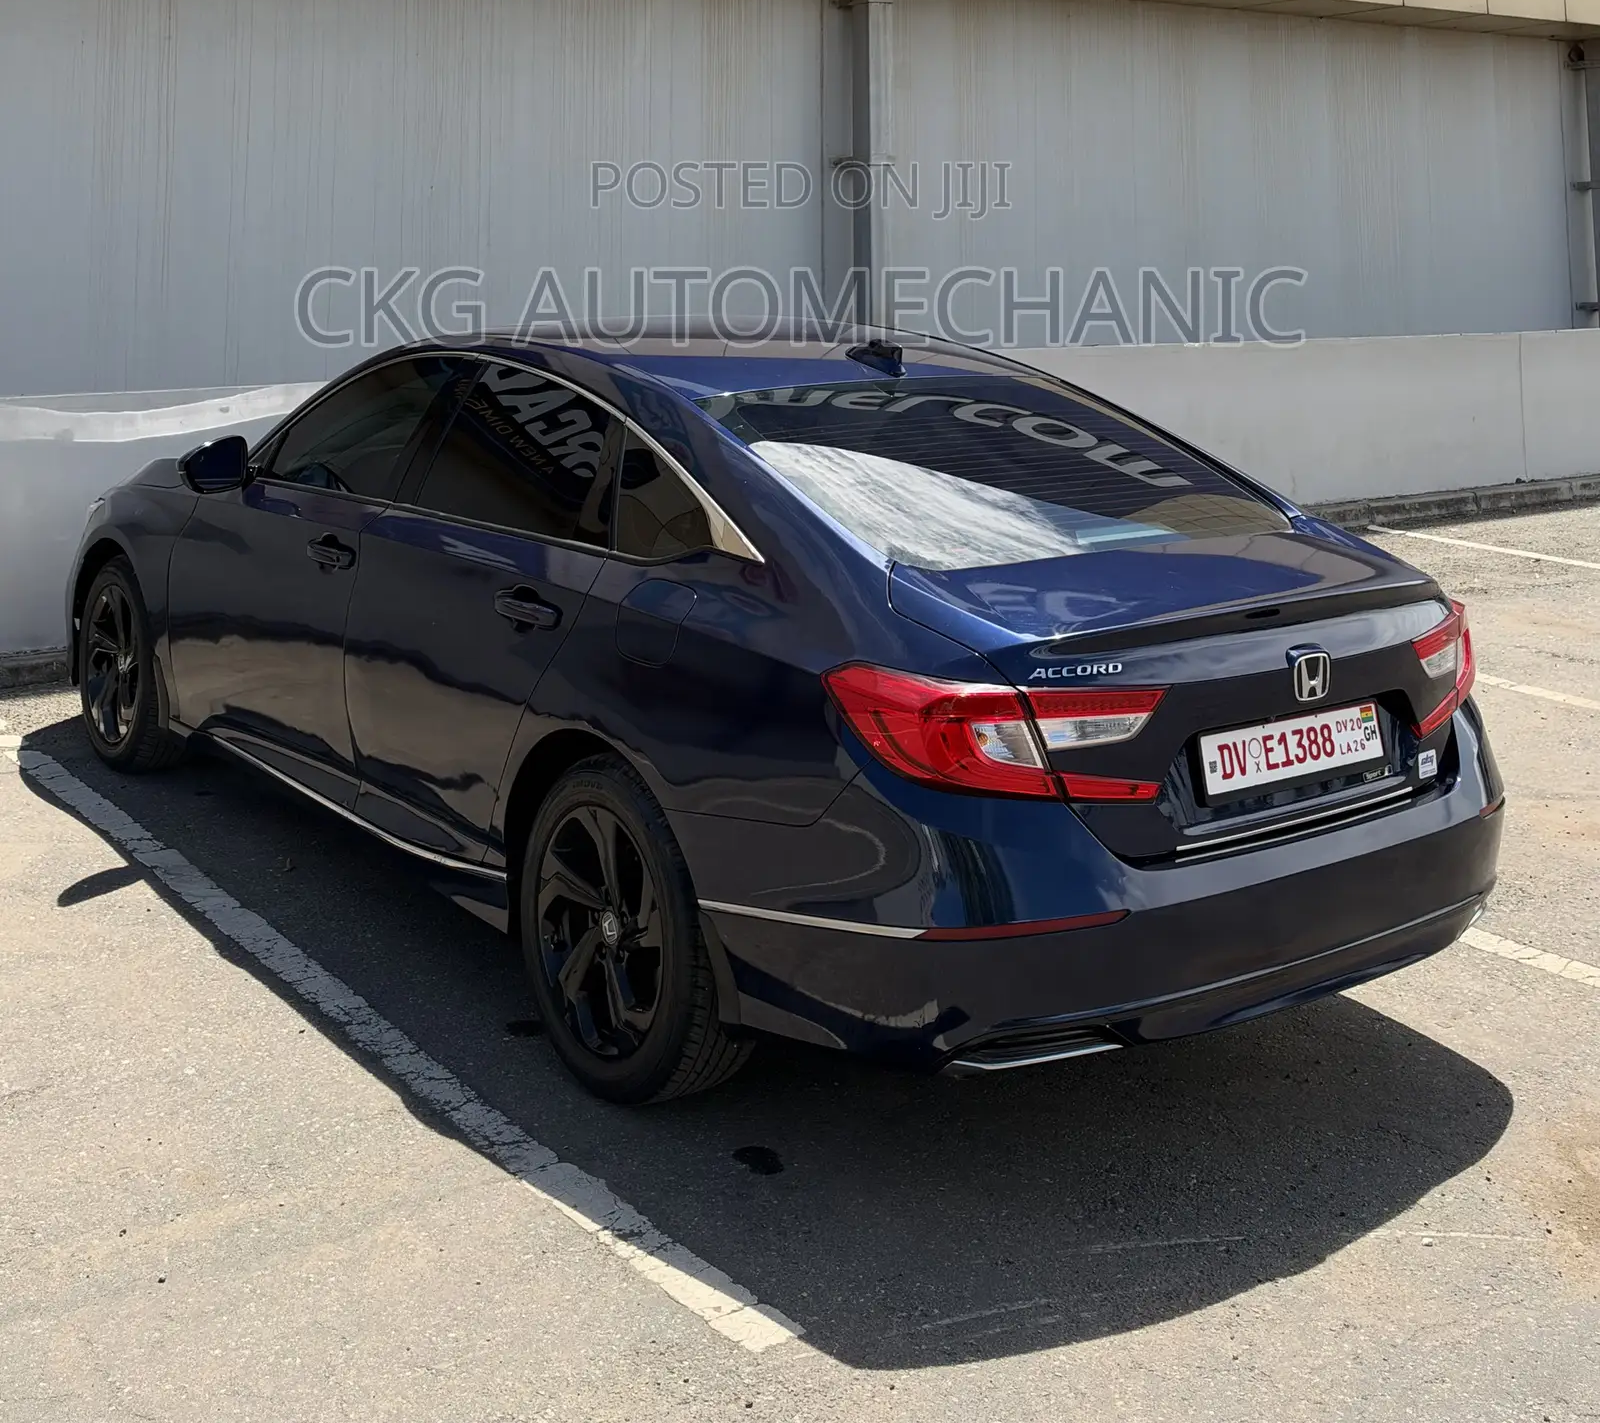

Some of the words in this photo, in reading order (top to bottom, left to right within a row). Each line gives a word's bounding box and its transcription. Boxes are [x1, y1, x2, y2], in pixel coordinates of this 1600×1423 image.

[1028, 662, 1123, 680] ACCORD
[1363, 724, 1378, 742] GH
[1217, 740, 1247, 780] DV
[1262, 724, 1336, 771] E1388
